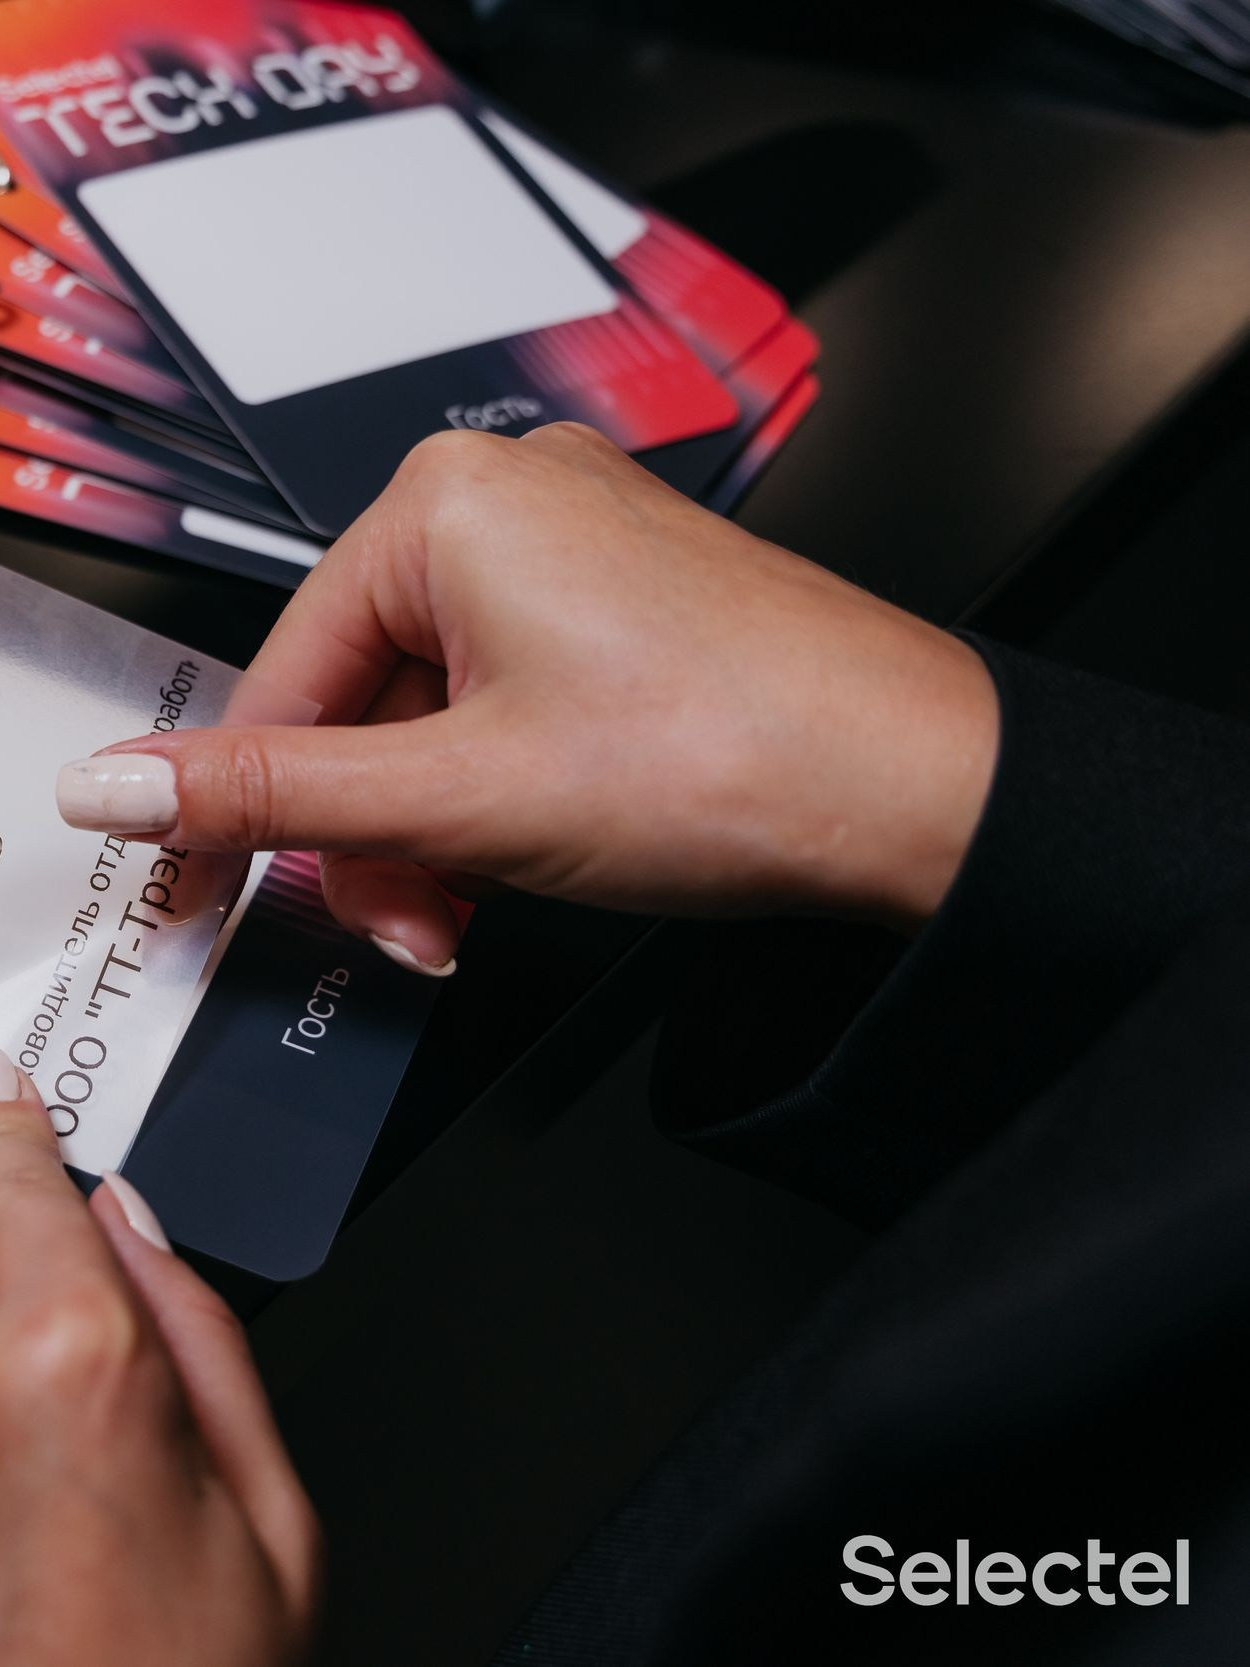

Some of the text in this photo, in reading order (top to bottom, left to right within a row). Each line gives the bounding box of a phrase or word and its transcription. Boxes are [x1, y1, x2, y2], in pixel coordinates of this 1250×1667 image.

[13, 33, 422, 158] TECH DAY
[18, 901, 100, 1076] оводитель
[90, 834, 129, 893] отд
[281, 967, 350, 1055] Гость
